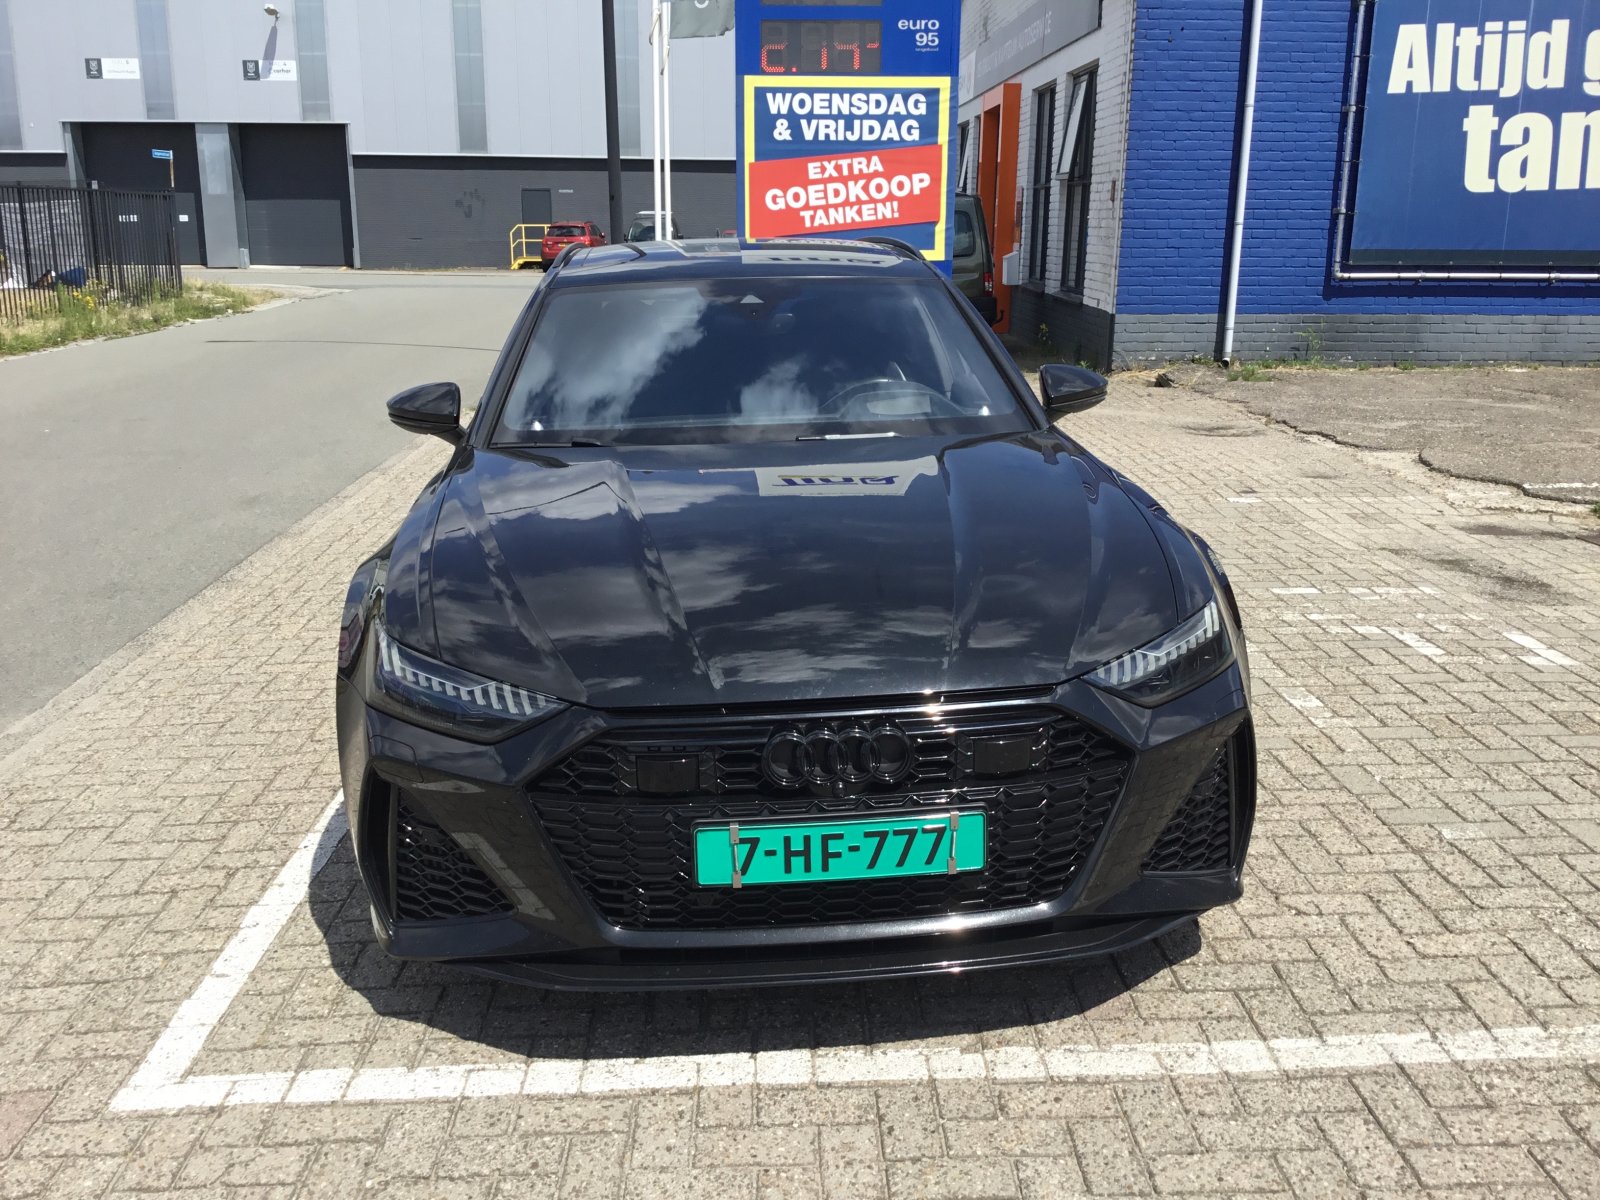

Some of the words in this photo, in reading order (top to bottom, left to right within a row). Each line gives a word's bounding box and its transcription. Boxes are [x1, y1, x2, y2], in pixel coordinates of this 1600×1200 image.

[898, 19, 939, 30] euro
[915, 32, 939, 46] 95
[1387, 19, 1570, 98] Altijd
[766, 93, 927, 116] WOENSDAG
[773, 118, 792, 141] &
[800, 119, 920, 141] VRIJDAG
[807, 155, 884, 180] EXTRA
[765, 173, 931, 211] GOEDKOOP
[800, 201, 899, 228] TANKEN!
[737, 824, 947, 876] 7-HF-777
